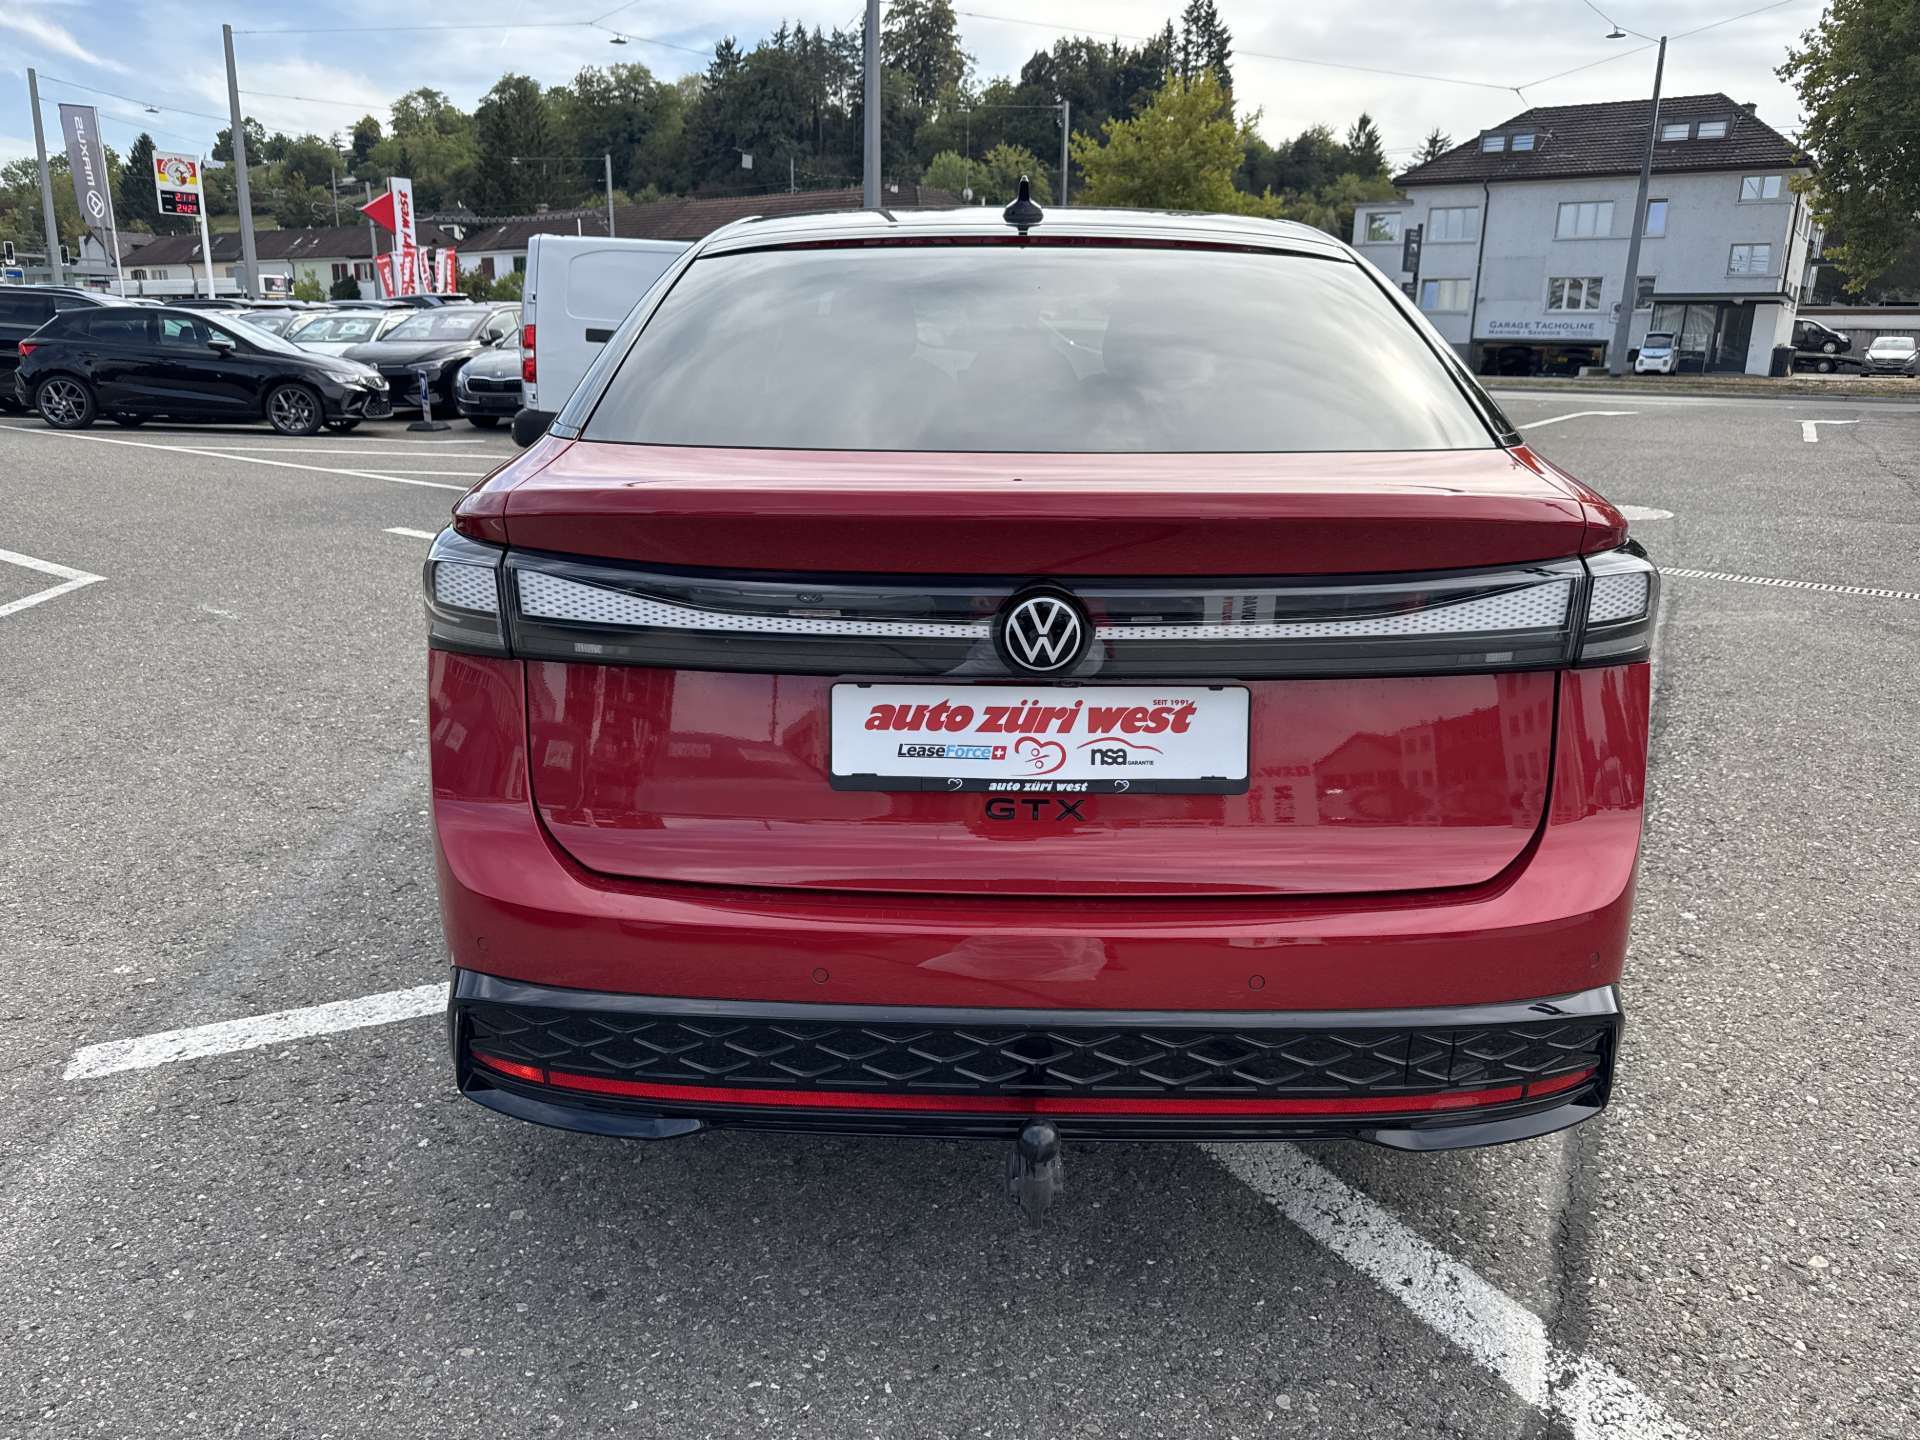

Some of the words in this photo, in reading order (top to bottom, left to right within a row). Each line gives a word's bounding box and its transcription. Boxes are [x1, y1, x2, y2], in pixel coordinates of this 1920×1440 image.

[1489, 320, 1532, 329] GARAGE
[1534, 321, 1595, 330] TACHOLINE
[1006, 598, 1080, 670] VW
[864, 699, 975, 733] auto
[975, 699, 1084, 734] züri
[1087, 701, 1198, 734] west
[897, 743, 992, 759] LeaseForce
[1090, 748, 1128, 766] nsa
[988, 781, 1021, 792] auto
[1022, 781, 1054, 792] züri
[1056, 782, 1089, 792] west
[985, 797, 1086, 821] GTX
